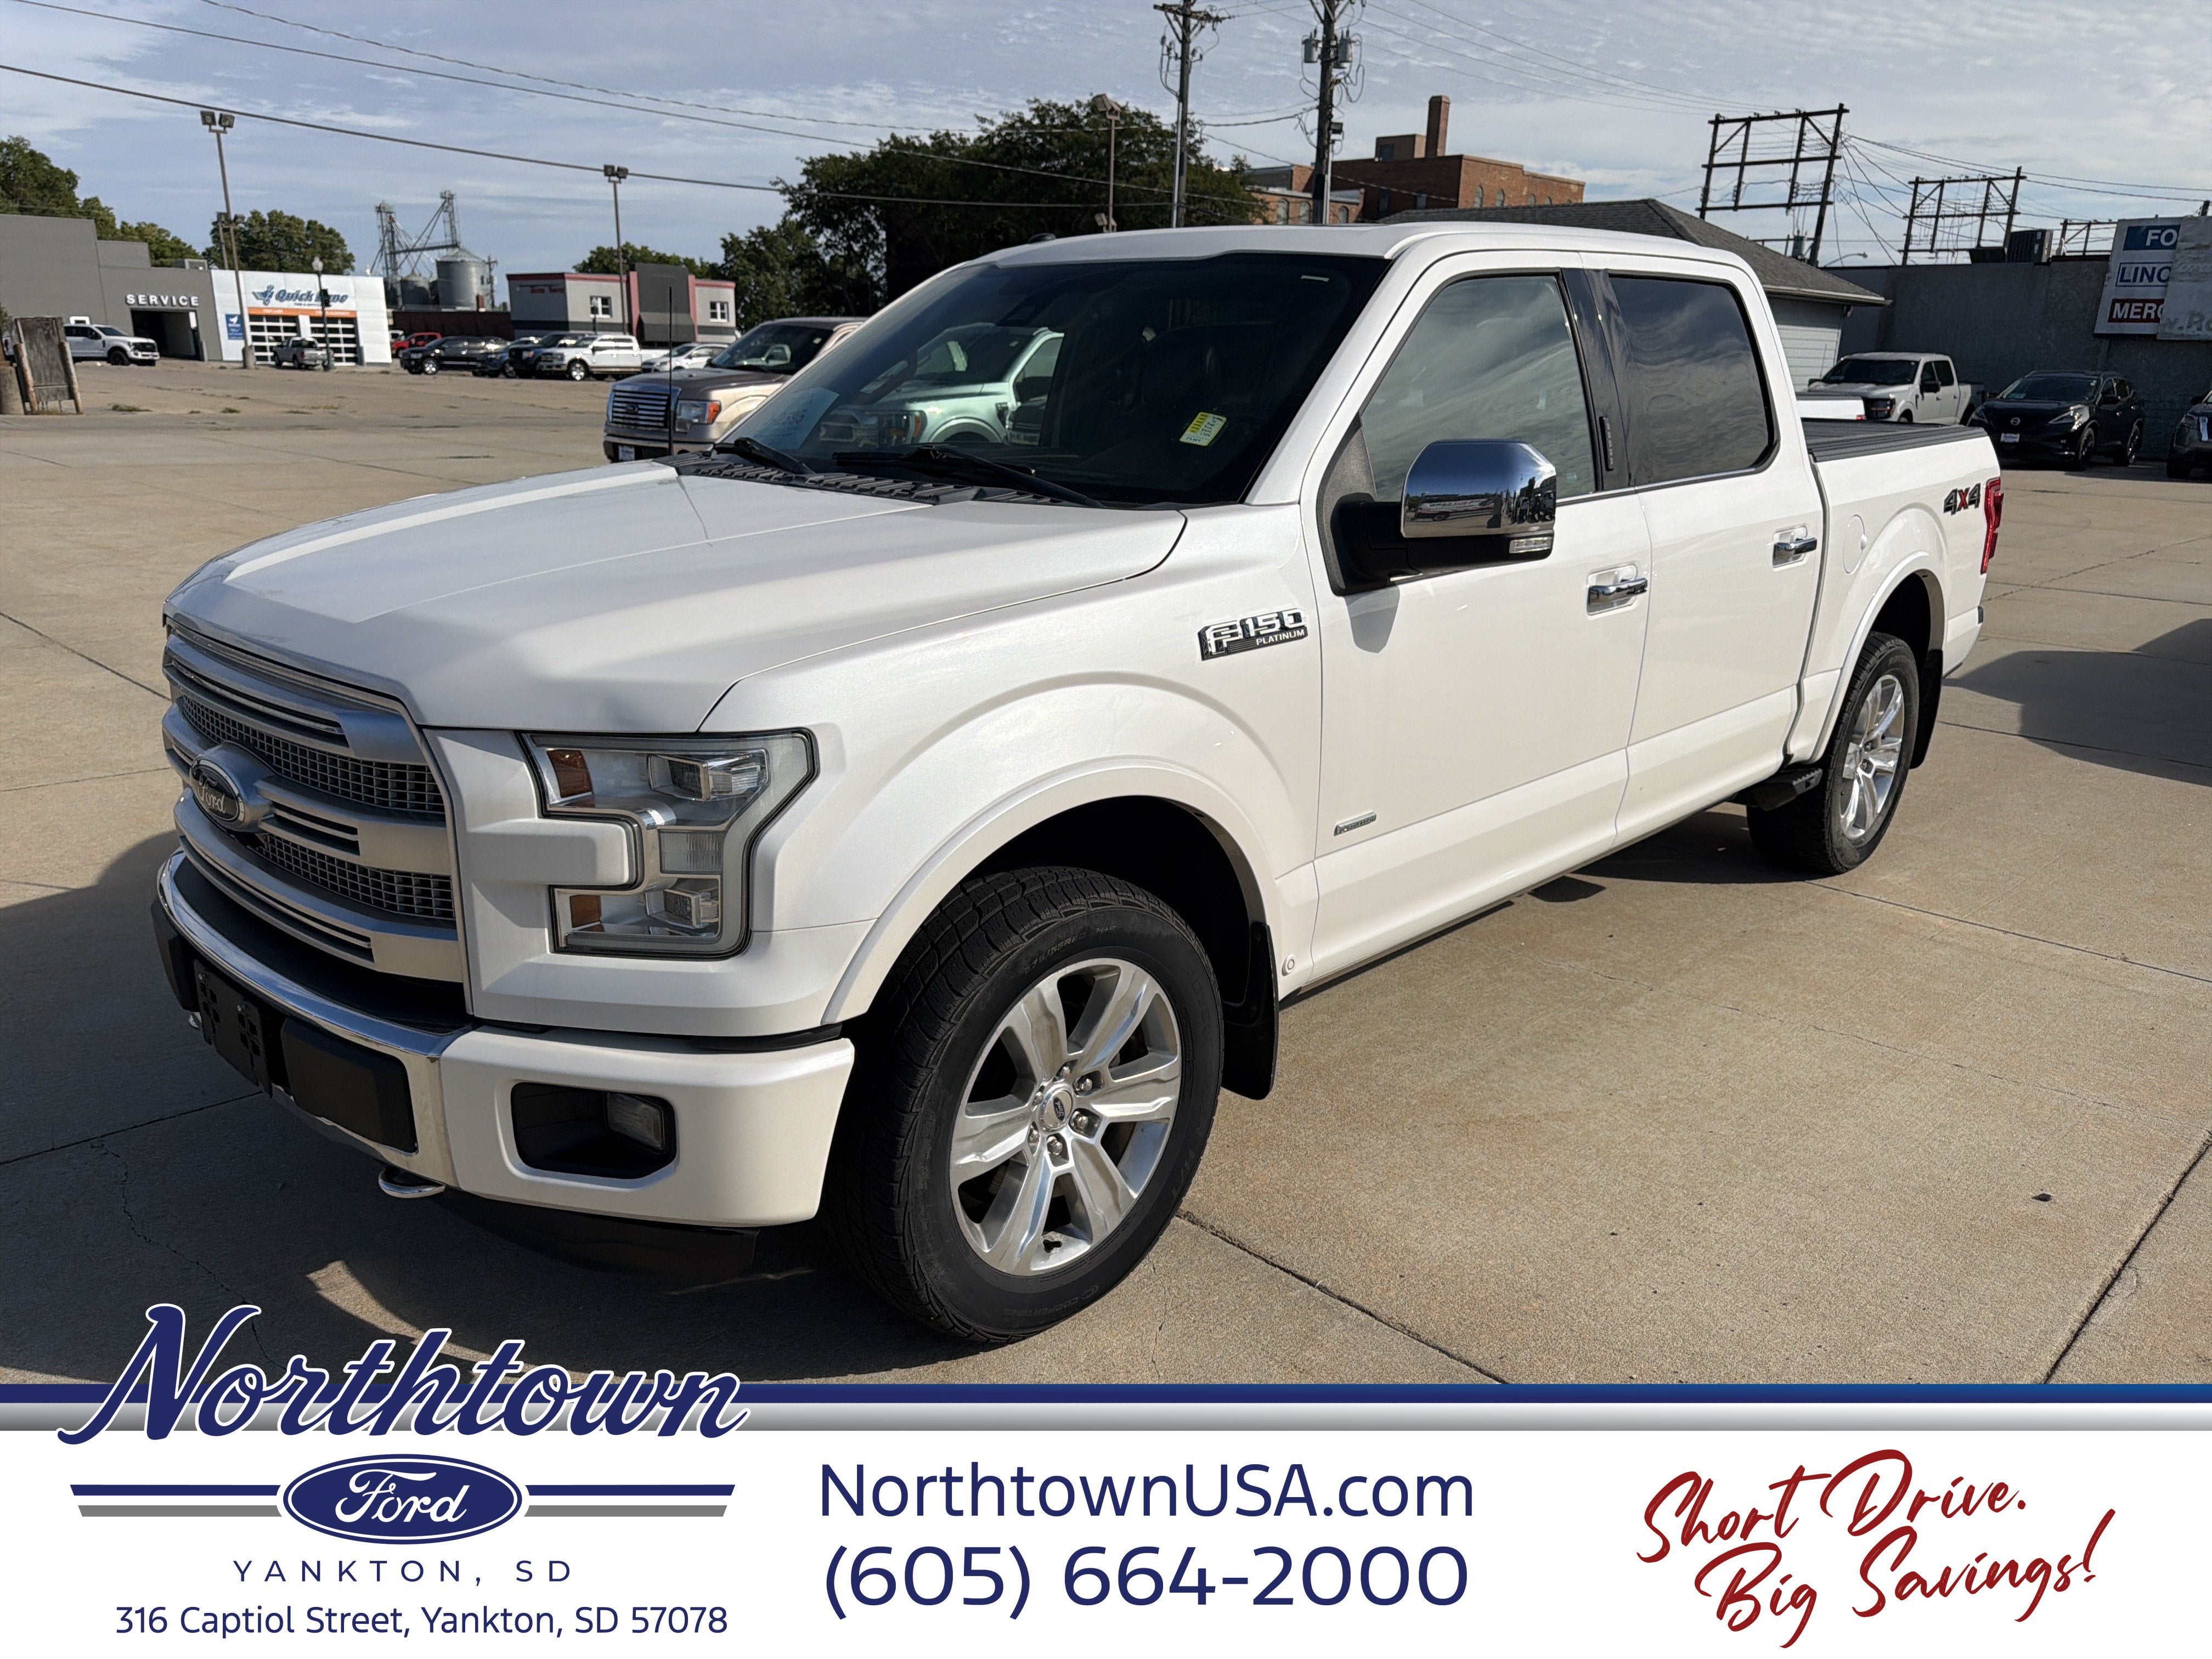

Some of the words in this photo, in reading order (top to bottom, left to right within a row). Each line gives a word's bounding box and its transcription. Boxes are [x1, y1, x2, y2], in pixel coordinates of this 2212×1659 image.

[126, 294, 199, 306] SERVICE
[275, 289, 314, 302] Quick
[1256, 629, 1305, 646] PLATINUM
[197, 774, 227, 814] Ford
